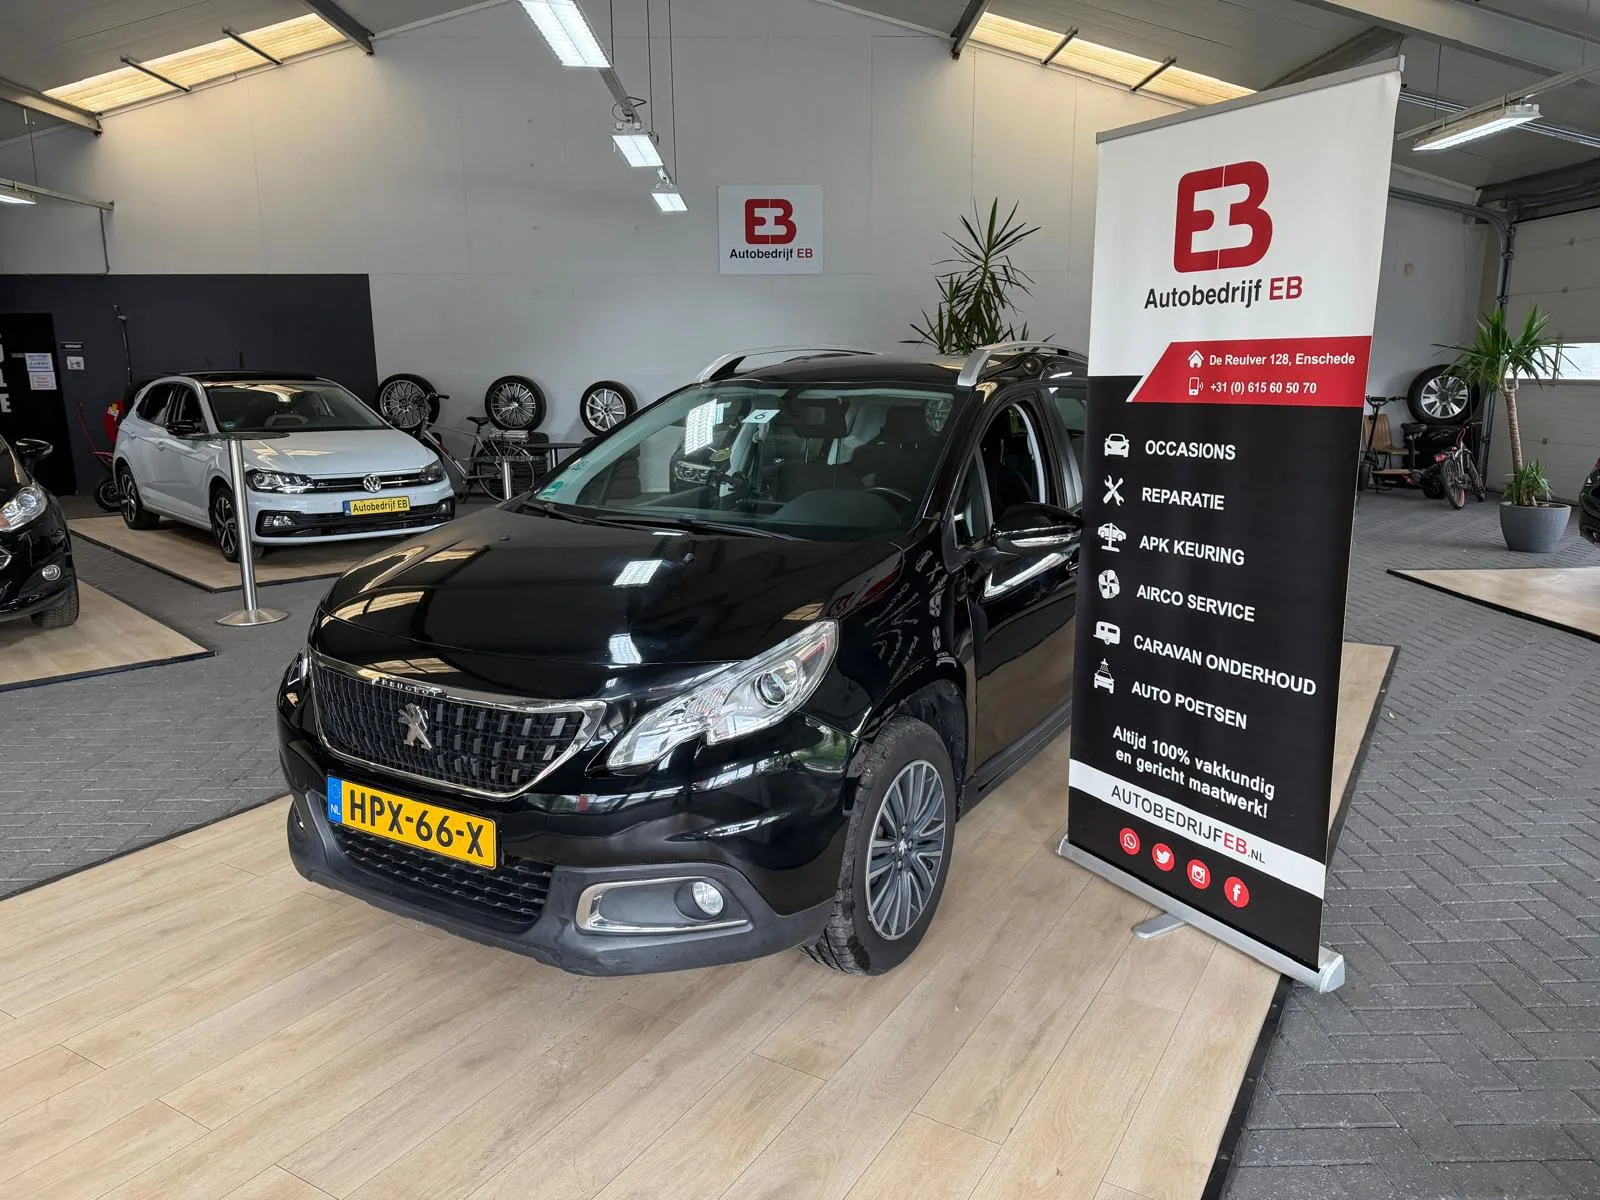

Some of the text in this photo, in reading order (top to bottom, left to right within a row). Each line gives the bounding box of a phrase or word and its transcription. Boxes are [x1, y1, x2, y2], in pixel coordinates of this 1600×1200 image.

[729, 248, 813, 261] Autobedrijf EB
[1144, 276, 1303, 309] Autobedrijf EB
[1209, 353, 1356, 367] De Reulver 128, Enschede
[1210, 381, 1317, 395] +31 (0) 615 60 50 70
[1145, 440, 1236, 461] OCCASIONS
[353, 501, 396, 513] Autobedrijf
[397, 499, 408, 509] EB
[1141, 487, 1225, 511] REPARATIE
[1139, 535, 1245, 566] APK KEURING
[1136, 584, 1256, 623] AIRCO SERVICE
[1133, 634, 1317, 696] CARAVAN ONDERHOUD
[1131, 681, 1247, 730] AUTO POETSEN
[1112, 725, 1275, 801] Altijd 100% vakkundig
[1115, 750, 1268, 819] en gericht maatwerk!
[330, 789, 484, 858] NL HPX-66-X
[1111, 785, 1266, 864] AUTOBEDRIJFEB.NL
